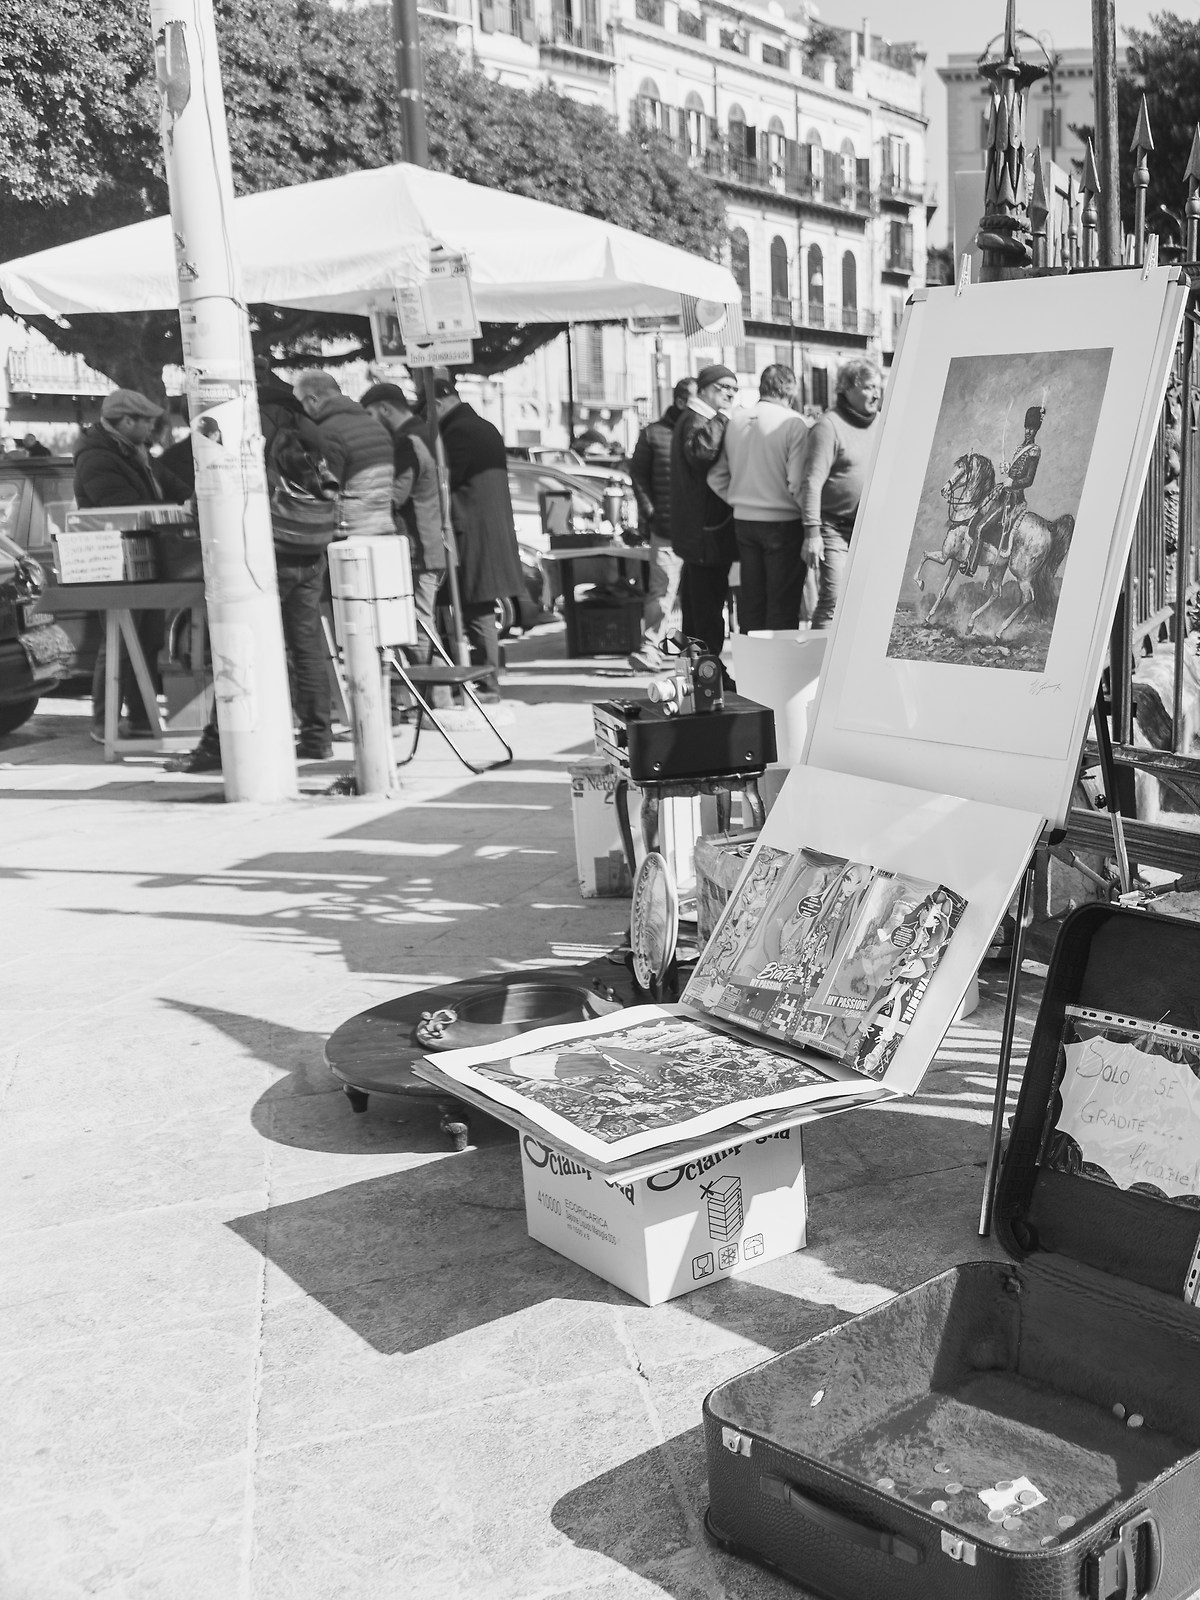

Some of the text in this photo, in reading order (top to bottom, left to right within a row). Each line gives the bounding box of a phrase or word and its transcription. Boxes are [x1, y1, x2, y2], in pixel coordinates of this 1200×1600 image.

[756, 960, 798, 983] Bratz
[826, 994, 839, 1006] MY
[901, 976, 930, 1022] YASMIN
[1153, 1076, 1180, 1099] SE
[564, 1198, 609, 1230] ECORICARICA
